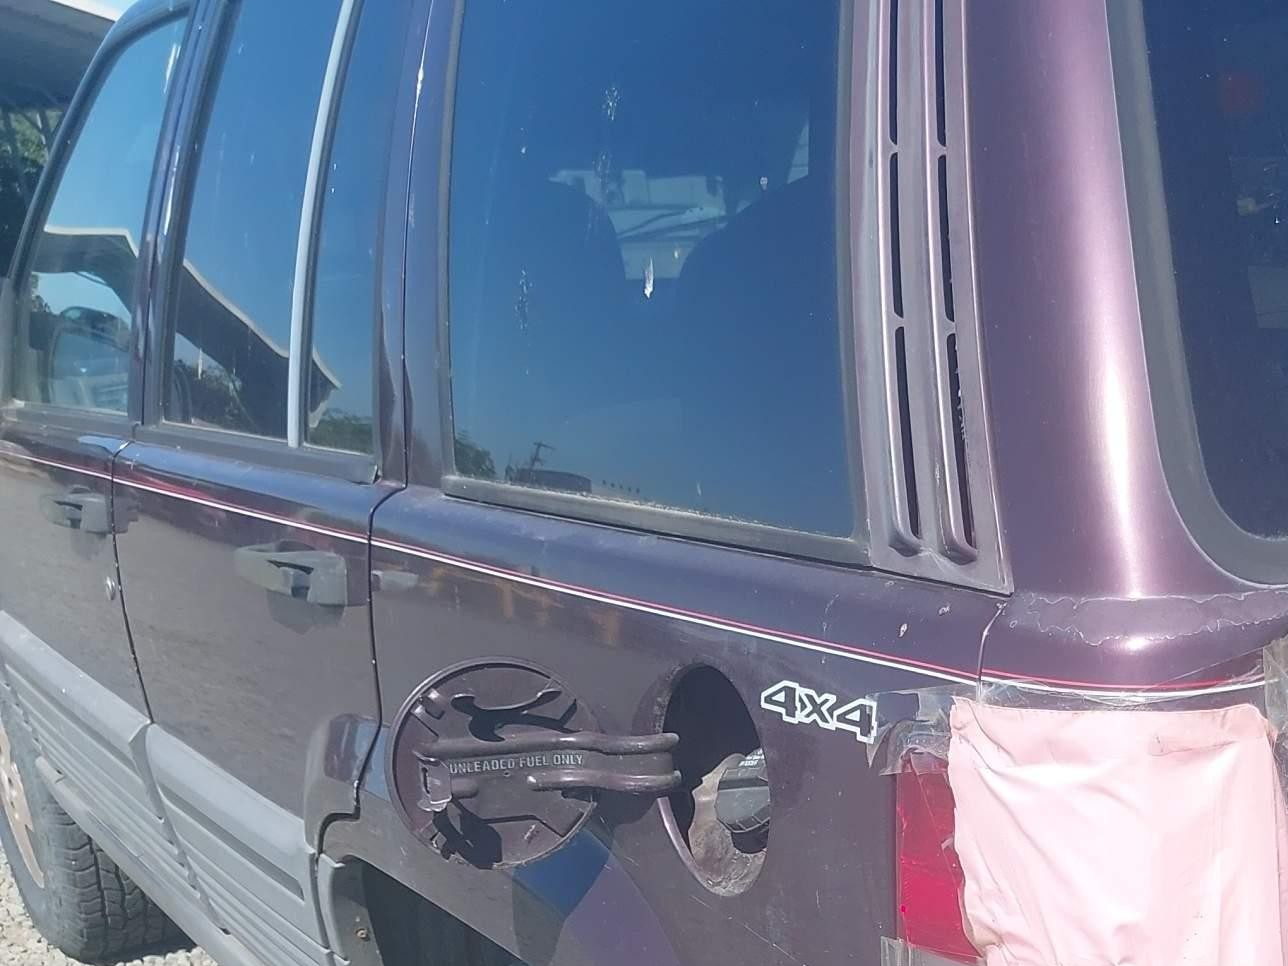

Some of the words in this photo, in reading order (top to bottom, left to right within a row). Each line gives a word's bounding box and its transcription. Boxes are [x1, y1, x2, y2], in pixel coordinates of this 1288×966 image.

[449, 758, 515, 774] UNLEADED
[519, 756, 549, 768] FUEL
[553, 754, 584, 765] ONLY
